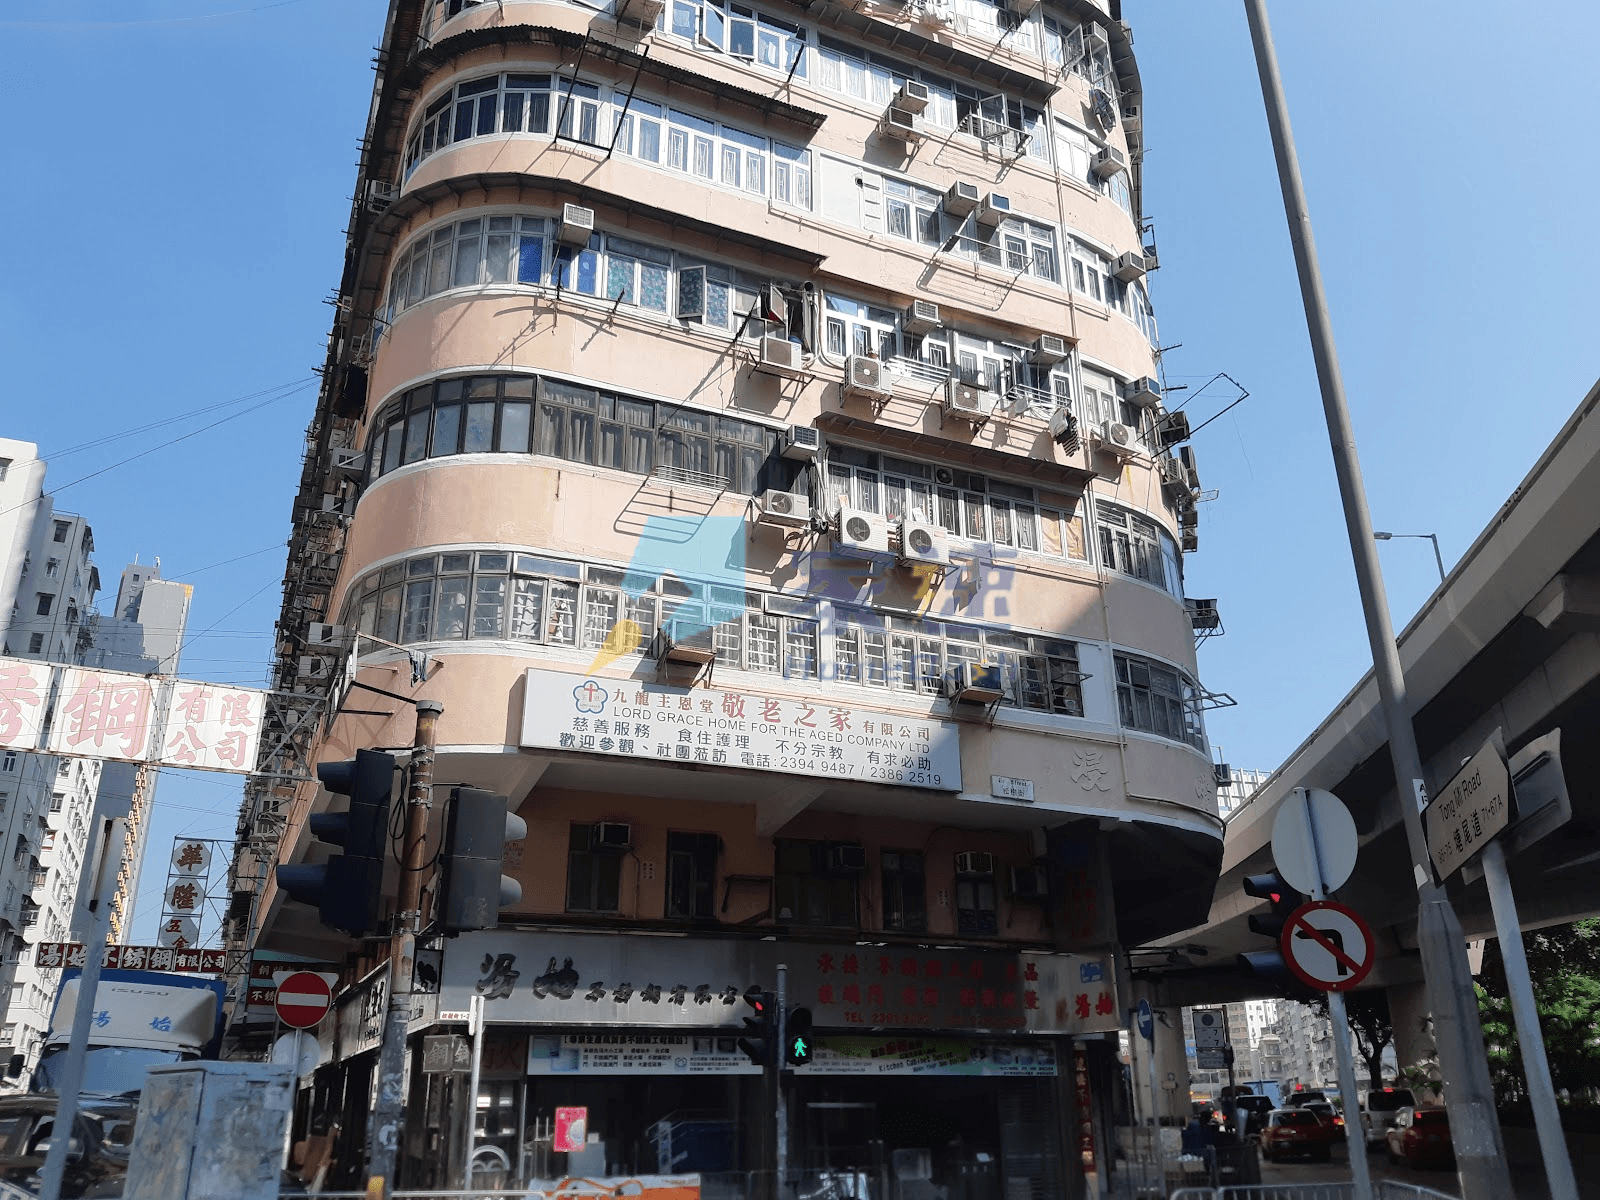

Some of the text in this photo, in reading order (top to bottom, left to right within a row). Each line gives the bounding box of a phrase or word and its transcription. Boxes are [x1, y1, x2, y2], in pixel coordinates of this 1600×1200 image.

[175, 687, 256, 728] 有限
[167, 726, 248, 767] 公司
[572, 716, 931, 771] 慈善服務 食住護理 不分宗教 有求必助
[613, 706, 930, 754] LORD GRACE HOME FOR THE AGED COMPANY LTD
[821, 760, 855, 775] 9487
[870, 766, 904, 781] 2386
[909, 771, 941, 786] 2519
[1438, 799, 1455, 822] Tong
[1461, 767, 1482, 800] Road
[111, 988, 169, 996] ISUZU
